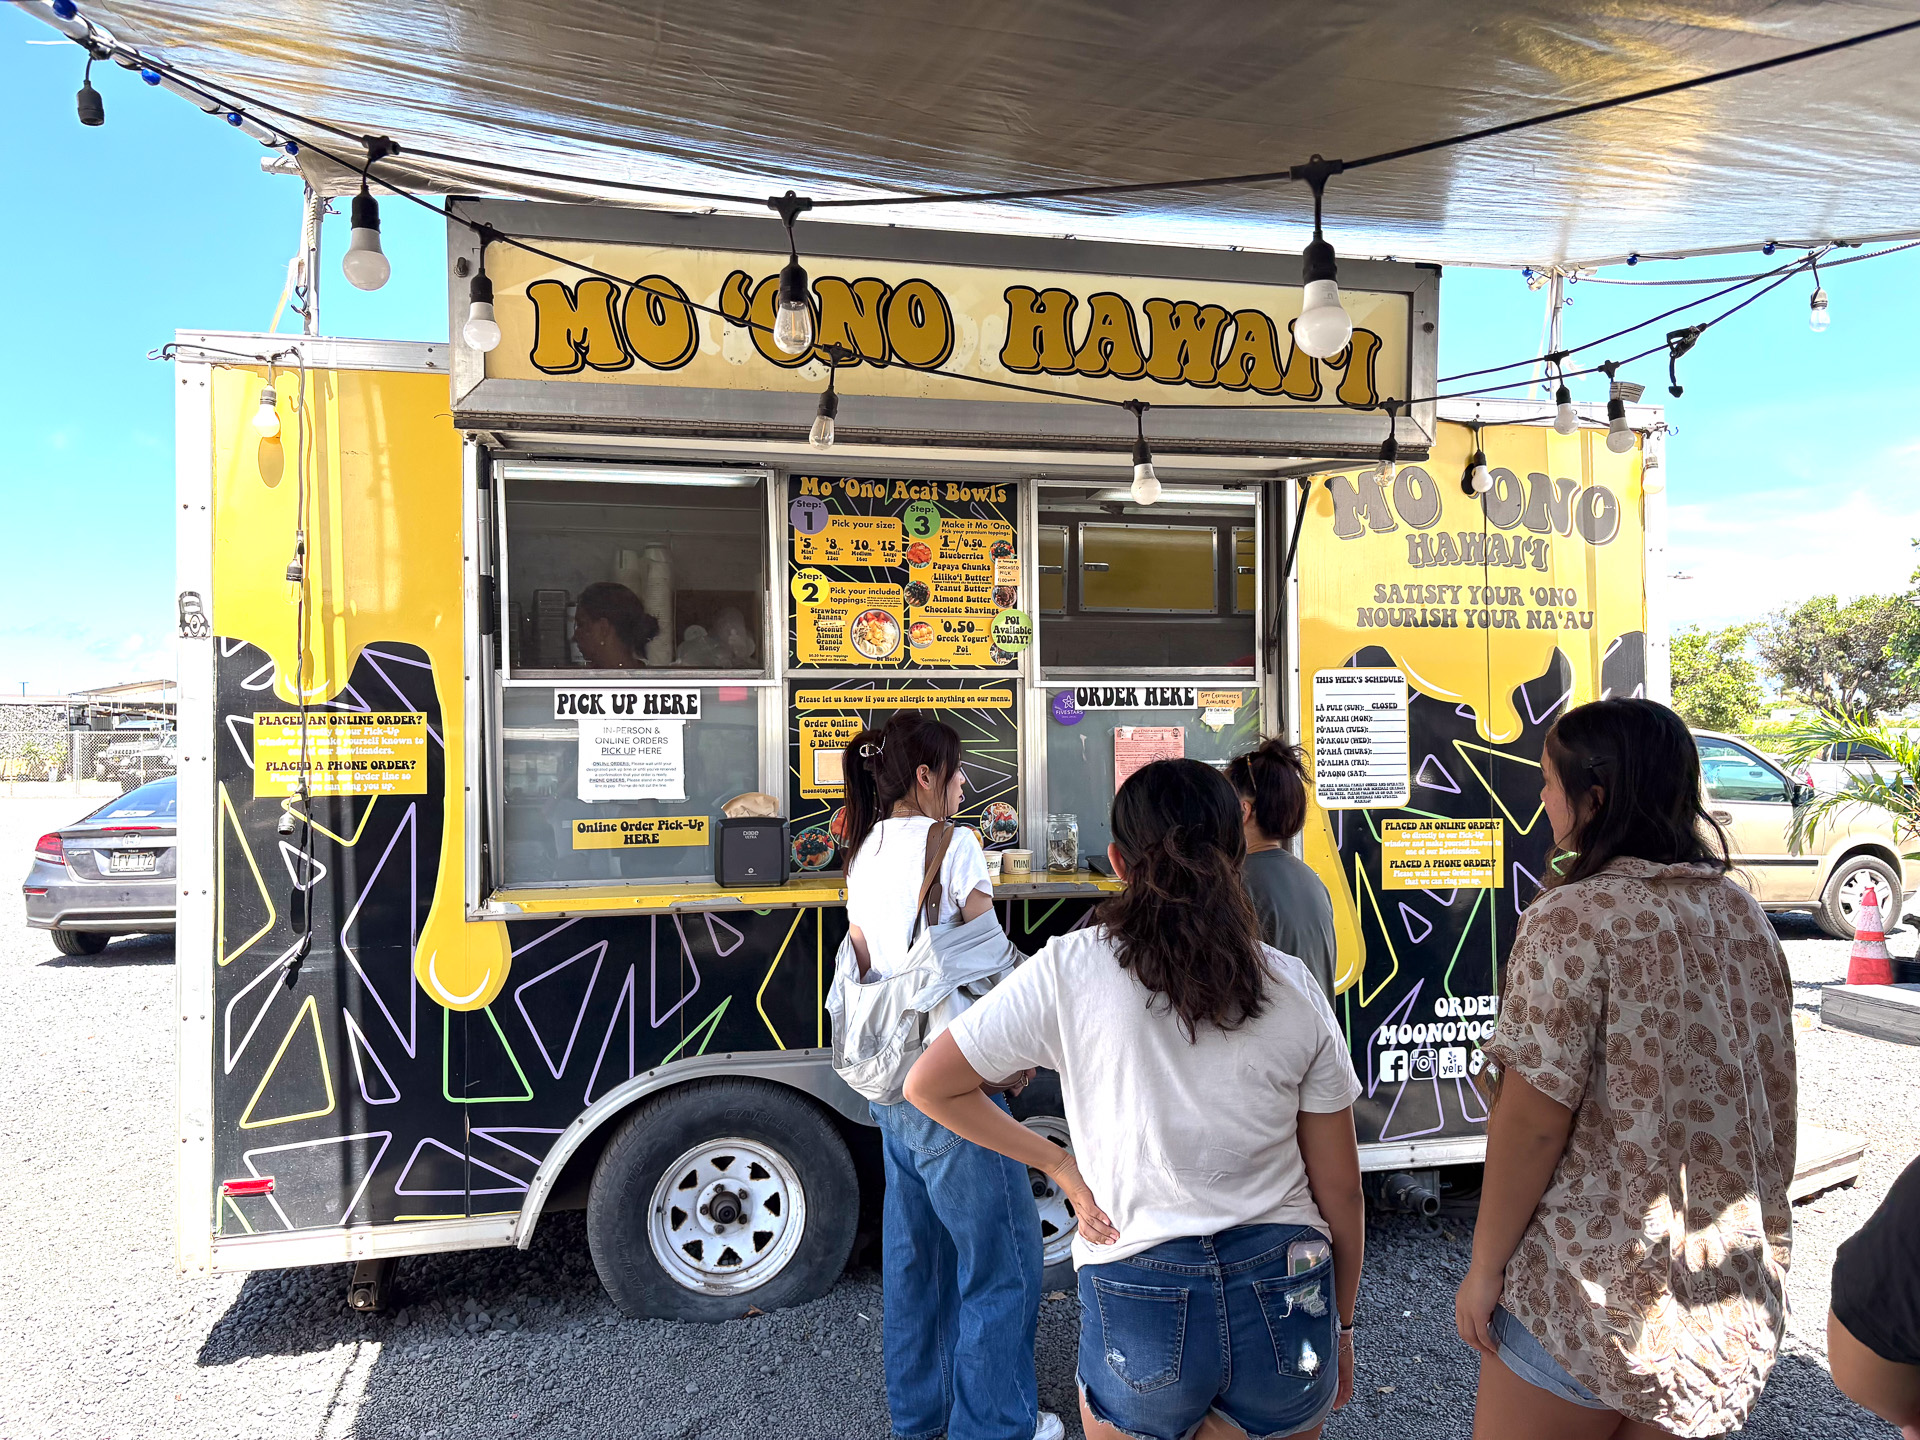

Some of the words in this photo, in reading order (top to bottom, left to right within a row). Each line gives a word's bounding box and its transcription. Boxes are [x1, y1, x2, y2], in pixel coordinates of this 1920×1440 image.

[526, 274, 700, 374] MO
[800, 477, 832, 496] Mo
[892, 481, 939, 500] Acai
[945, 483, 1007, 503] Bowls
[796, 500, 822, 510] Step:
[1324, 466, 1442, 540] MO
[910, 505, 934, 515] Step:
[804, 512, 813, 530] 1
[832, 520, 850, 528] Pick
[876, 521, 896, 529] size:
[914, 516, 930, 535] 3
[942, 521, 965, 529] Make
[851, 539, 869, 551] $10
[877, 540, 896, 552] $15
[939, 552, 984, 560] Blueberries
[1406, 532, 1549, 572] HAWAI'I
[932, 562, 959, 572] Papaya
[962, 563, 991, 571] Chunks
[798, 572, 822, 581] Step:
[802, 583, 819, 602] 2
[848, 588, 866, 596] your
[934, 584, 961, 592] Peanut
[1374, 584, 1462, 605] SATISFY
[1468, 586, 1525, 606] YOUR
[1529, 586, 1577, 607] 'ONO
[830, 597, 866, 605] toppings:
[810, 607, 848, 615] Strawberry
[964, 607, 999, 616] Shavings
[1005, 616, 1020, 625] POI
[1357, 607, 1457, 628] NOURISH
[1464, 609, 1522, 629] YOUR
[1526, 610, 1594, 629] NA'AU
[993, 625, 1032, 635] Available
[996, 635, 1029, 644] TODAY!
[956, 645, 969, 653] Poi
[799, 695, 821, 703] Please
[822, 695, 833, 703] let
[844, 695, 864, 703] know
[865, 695, 871, 703] if
[899, 695, 925, 703] allergic
[935, 695, 966, 703] anything
[1077, 687, 1139, 707] ORDER
[1144, 687, 1194, 706] HERE
[557, 694, 606, 714] PICK
[611, 694, 638, 714] UP
[643, 694, 698, 714] HERE
[1371, 702, 1398, 710] CLOSED
[259, 716, 303, 725] PLACED
[308, 716, 326, 725] AN
[330, 716, 374, 725] ONLINE
[377, 716, 423, 725] ORDER?
[804, 719, 829, 728] Order
[831, 719, 859, 728] Online
[363, 728, 399, 736] Pick-Up
[813, 729, 833, 738] Take
[835, 729, 850, 738] Out
[343, 737, 379, 745] yourself
[381, 737, 412, 745] known
[810, 739, 816, 748] &
[601, 747, 621, 755] PICK
[623, 747, 636, 755] UP
[638, 747, 662, 755] HERE
[1343, 747, 1373, 755] (THURS):
[266, 761, 311, 770] PLACED
[315, 761, 324, 770] A
[328, 761, 367, 770] PHONE
[371, 761, 416, 770] ORDER?
[1351, 758, 1370, 766] (FRI):
[354, 773, 380, 781] Order
[1347, 769, 1367, 777] (SAT):
[577, 822, 617, 834] Online
[620, 821, 654, 832] Order
[657, 819, 704, 831] Pick-Up
[1385, 822, 1417, 830] PLACED
[1420, 822, 1432, 830] AN
[1435, 822, 1466, 830] ONLINE
[1468, 822, 1500, 830] ORDER?
[624, 833, 659, 845] HERE
[113, 854, 130, 866] LFV
[137, 853, 154, 866] 172
[1013, 859, 1029, 868] MINI
[1390, 859, 1421, 868] PLACED
[1424, 859, 1431, 868] A
[1433, 859, 1462, 868] PHONE
[1463, 859, 1496, 868] ORDER?
[1443, 1064, 1463, 1075] yelp
